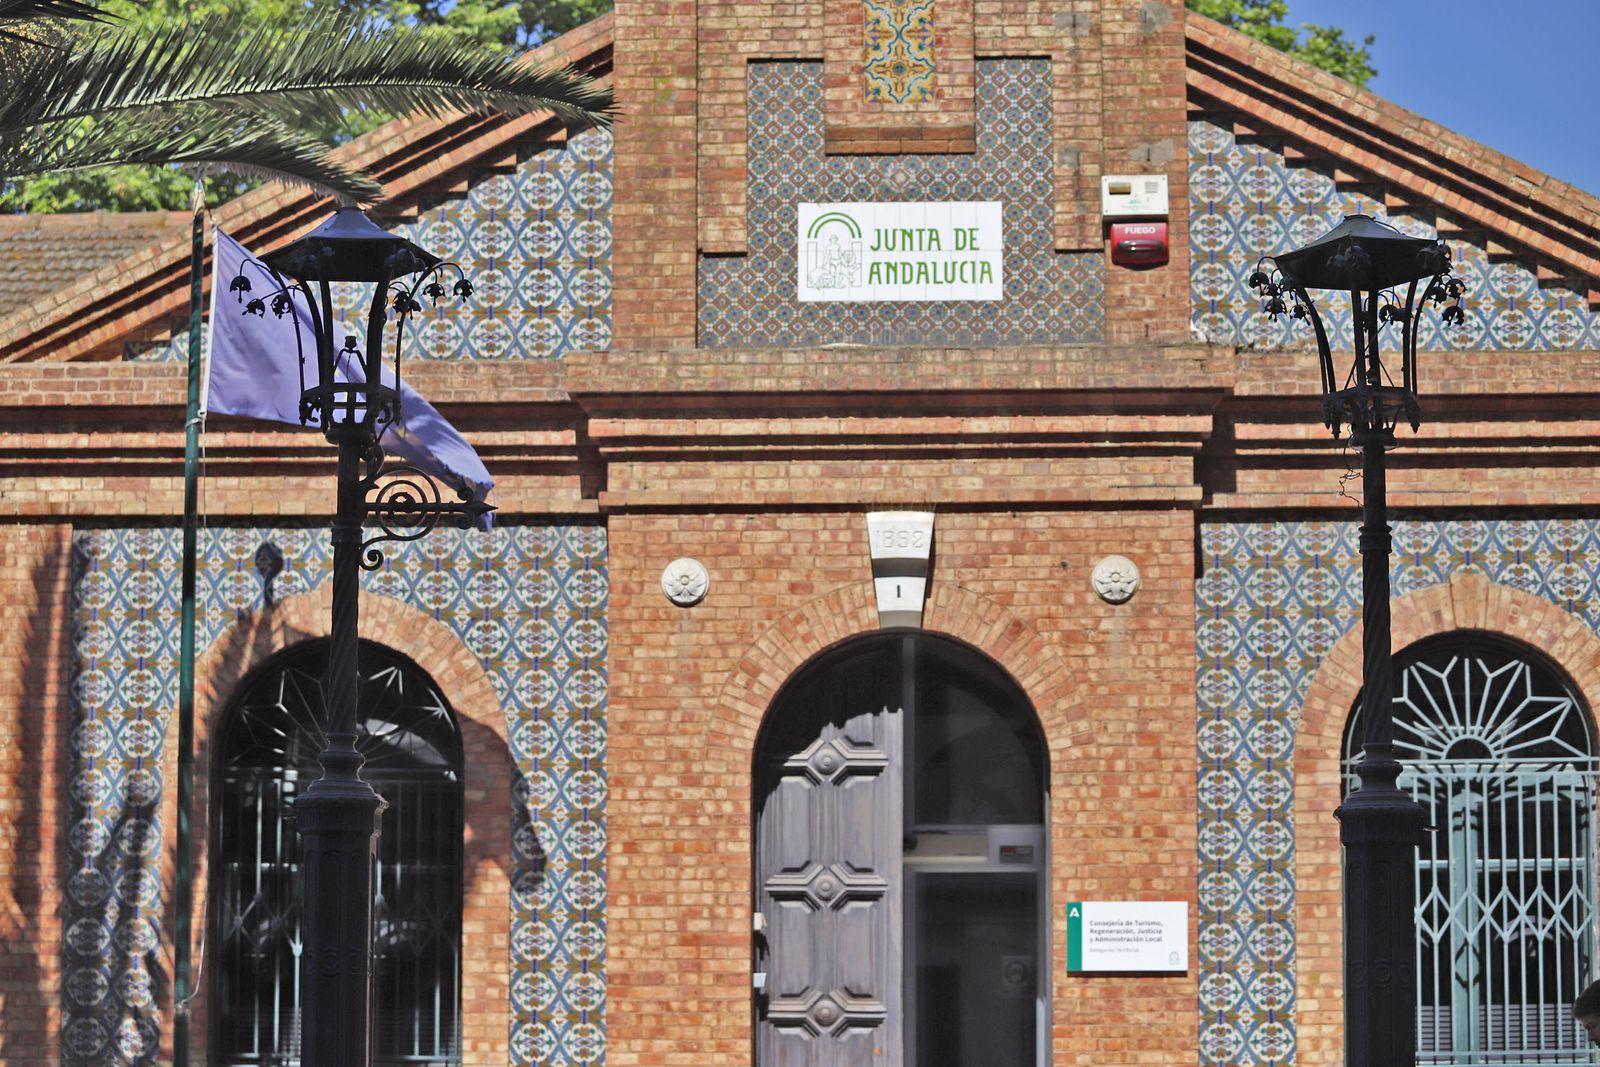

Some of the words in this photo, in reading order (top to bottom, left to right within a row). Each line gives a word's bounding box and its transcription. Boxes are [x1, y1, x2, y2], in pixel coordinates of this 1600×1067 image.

[1124, 226, 1156, 234] FUEGO
[870, 228, 941, 251] JUNTA
[954, 228, 980, 251] DE
[1089, 920, 1124, 928] Consejería
[1089, 928, 1135, 936] Regeneración,
